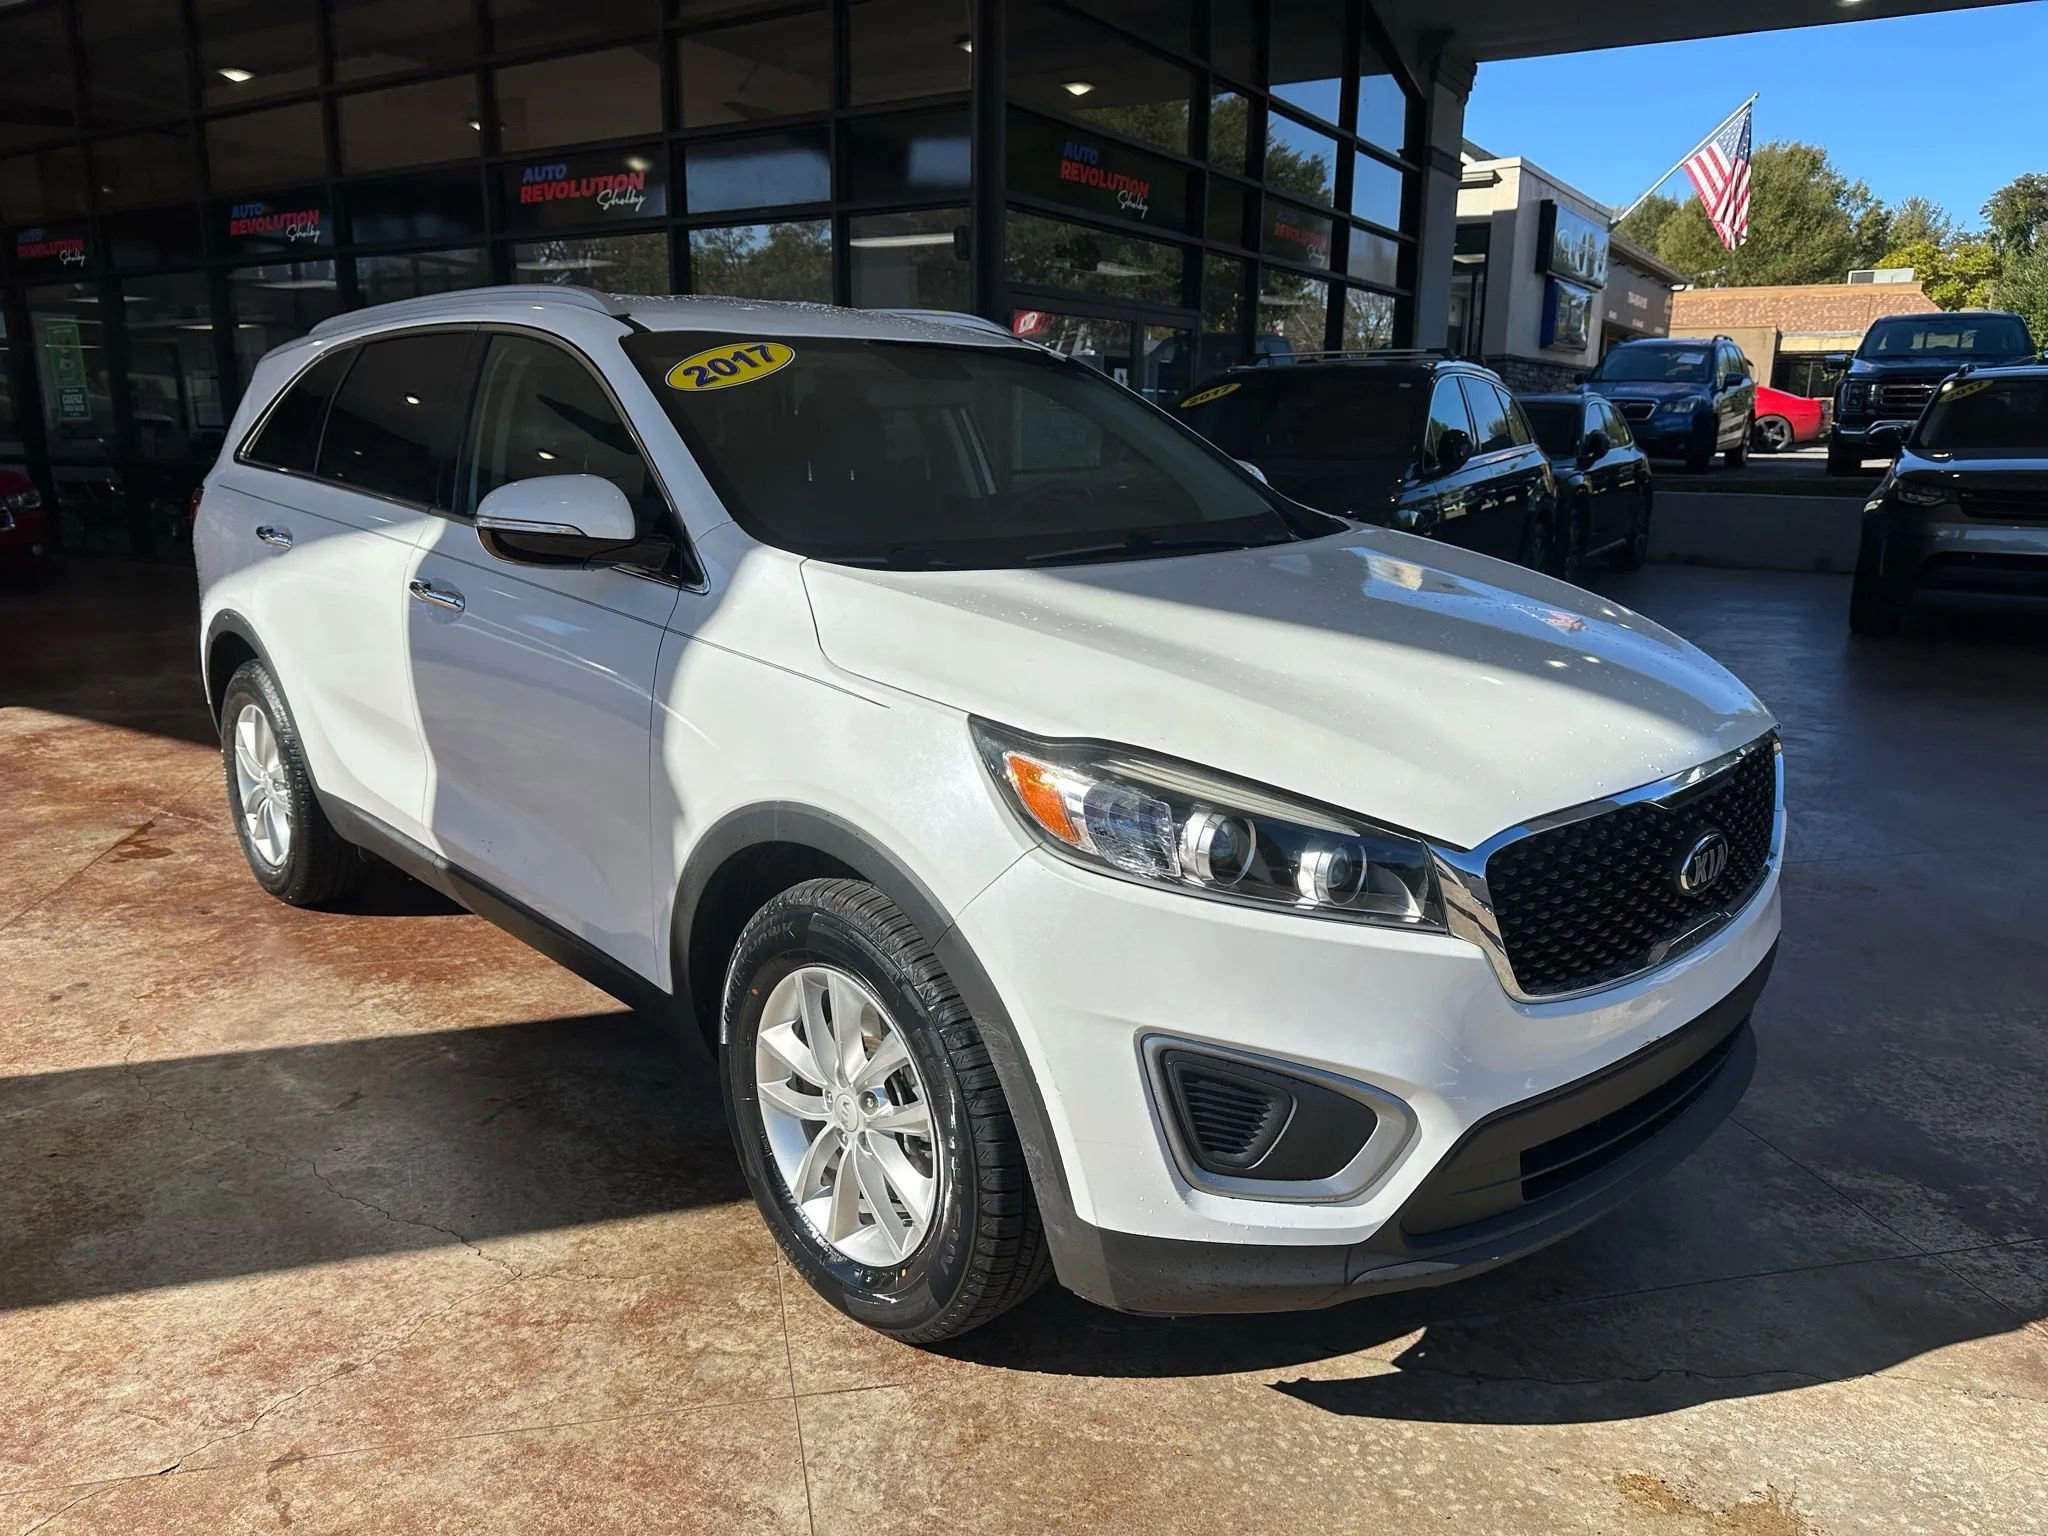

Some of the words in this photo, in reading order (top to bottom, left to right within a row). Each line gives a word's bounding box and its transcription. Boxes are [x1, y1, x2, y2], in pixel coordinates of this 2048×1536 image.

[1063, 142, 1098, 165] AUTO
[522, 163, 567, 183] AUTO
[1060, 159, 1150, 199] REVOLUTION
[519, 172, 645, 204] REVOLUTION
[596, 186, 646, 211] Shelby
[229, 208, 320, 236] REVOLUTION
[231, 203, 264, 219] AUTO
[286, 222, 321, 243] Shelby
[682, 344, 773, 387] 2017
[1692, 844, 1724, 886] KIA
